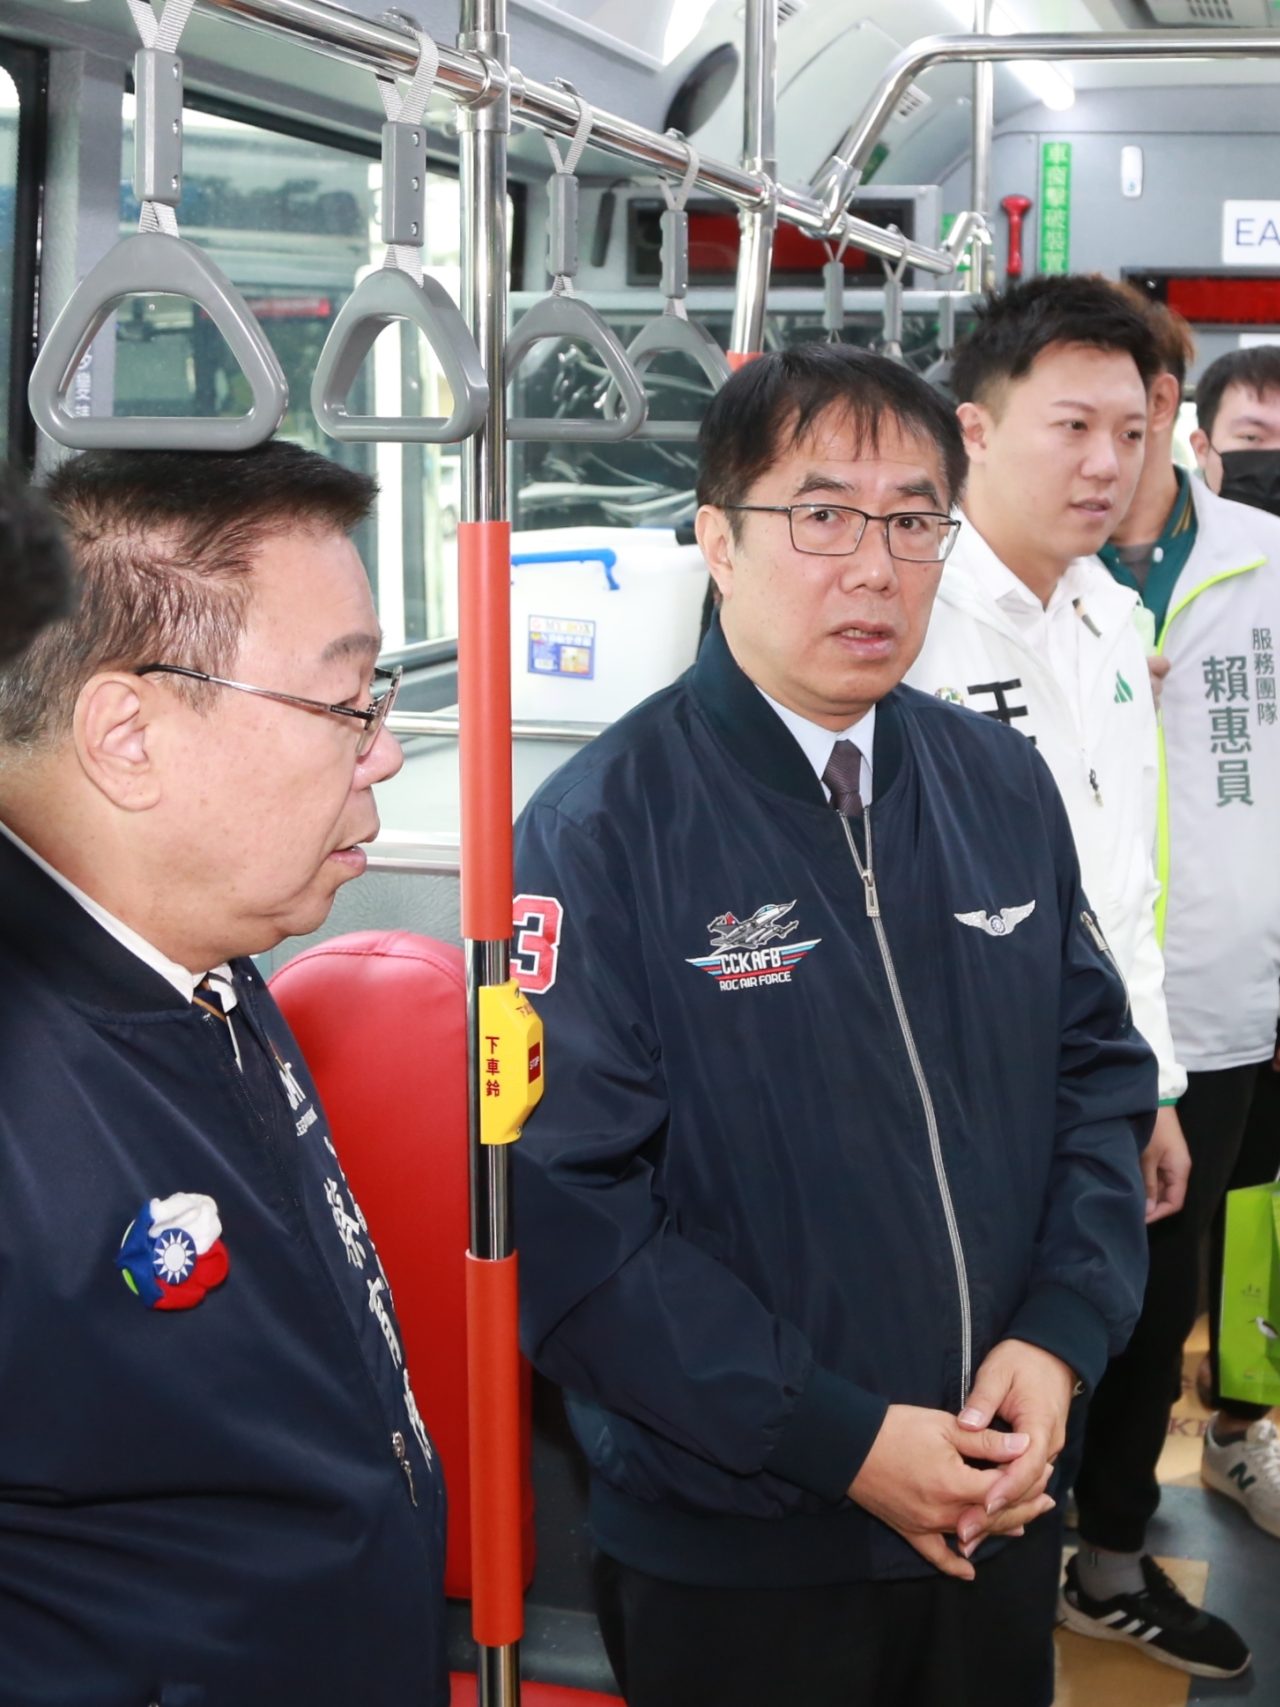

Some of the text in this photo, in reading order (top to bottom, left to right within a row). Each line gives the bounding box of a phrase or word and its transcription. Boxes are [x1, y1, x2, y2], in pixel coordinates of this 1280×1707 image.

[1252, 627, 1278, 726] 服務團隊
[1202, 655, 1254, 809] 賴惠員
[719, 948, 782, 975] CCKAFB
[719, 970, 792, 992] ROC AIR FORCE
[485, 1036, 501, 1097] 下車鈴
